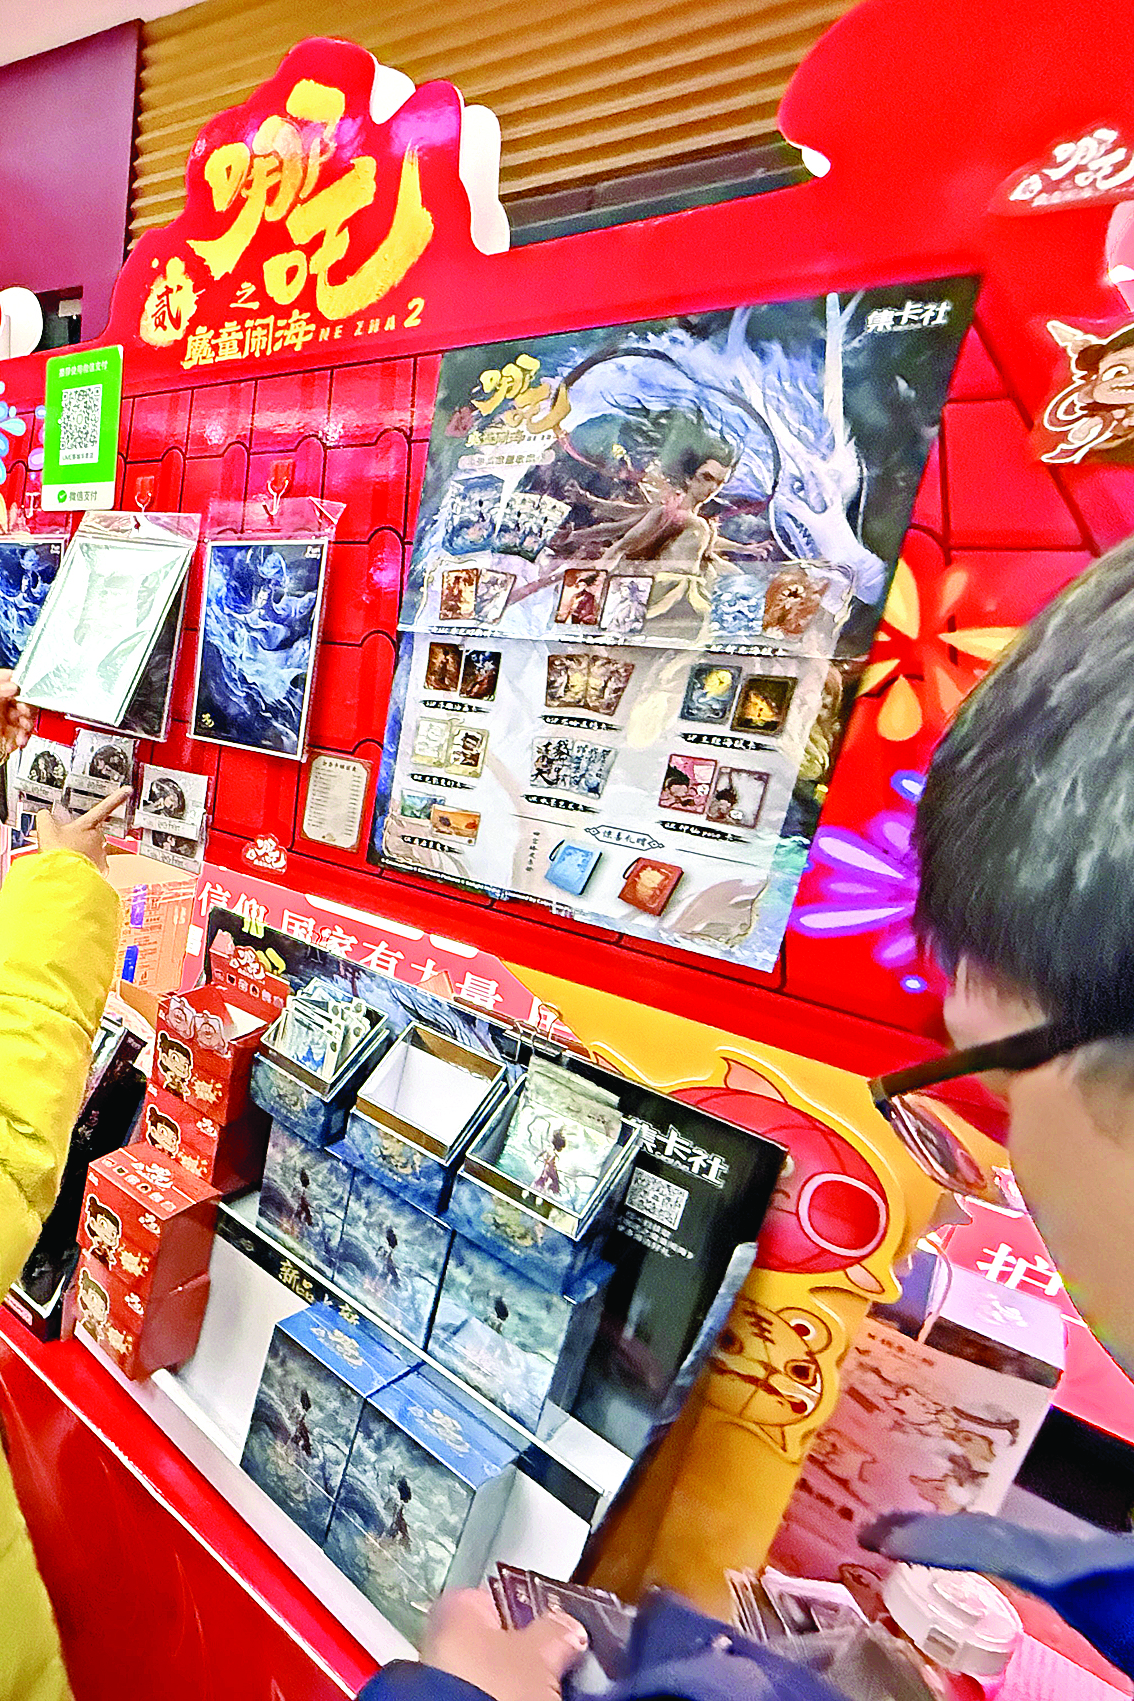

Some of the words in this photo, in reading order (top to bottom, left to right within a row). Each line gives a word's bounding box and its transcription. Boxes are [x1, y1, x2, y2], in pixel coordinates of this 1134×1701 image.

[229, 281, 260, 309] 之
[404, 297, 425, 328] 2
[866, 300, 953, 333] 集卡社
[180, 309, 316, 370] 魔童闹海
[69, 490, 98, 502] 微信支付
